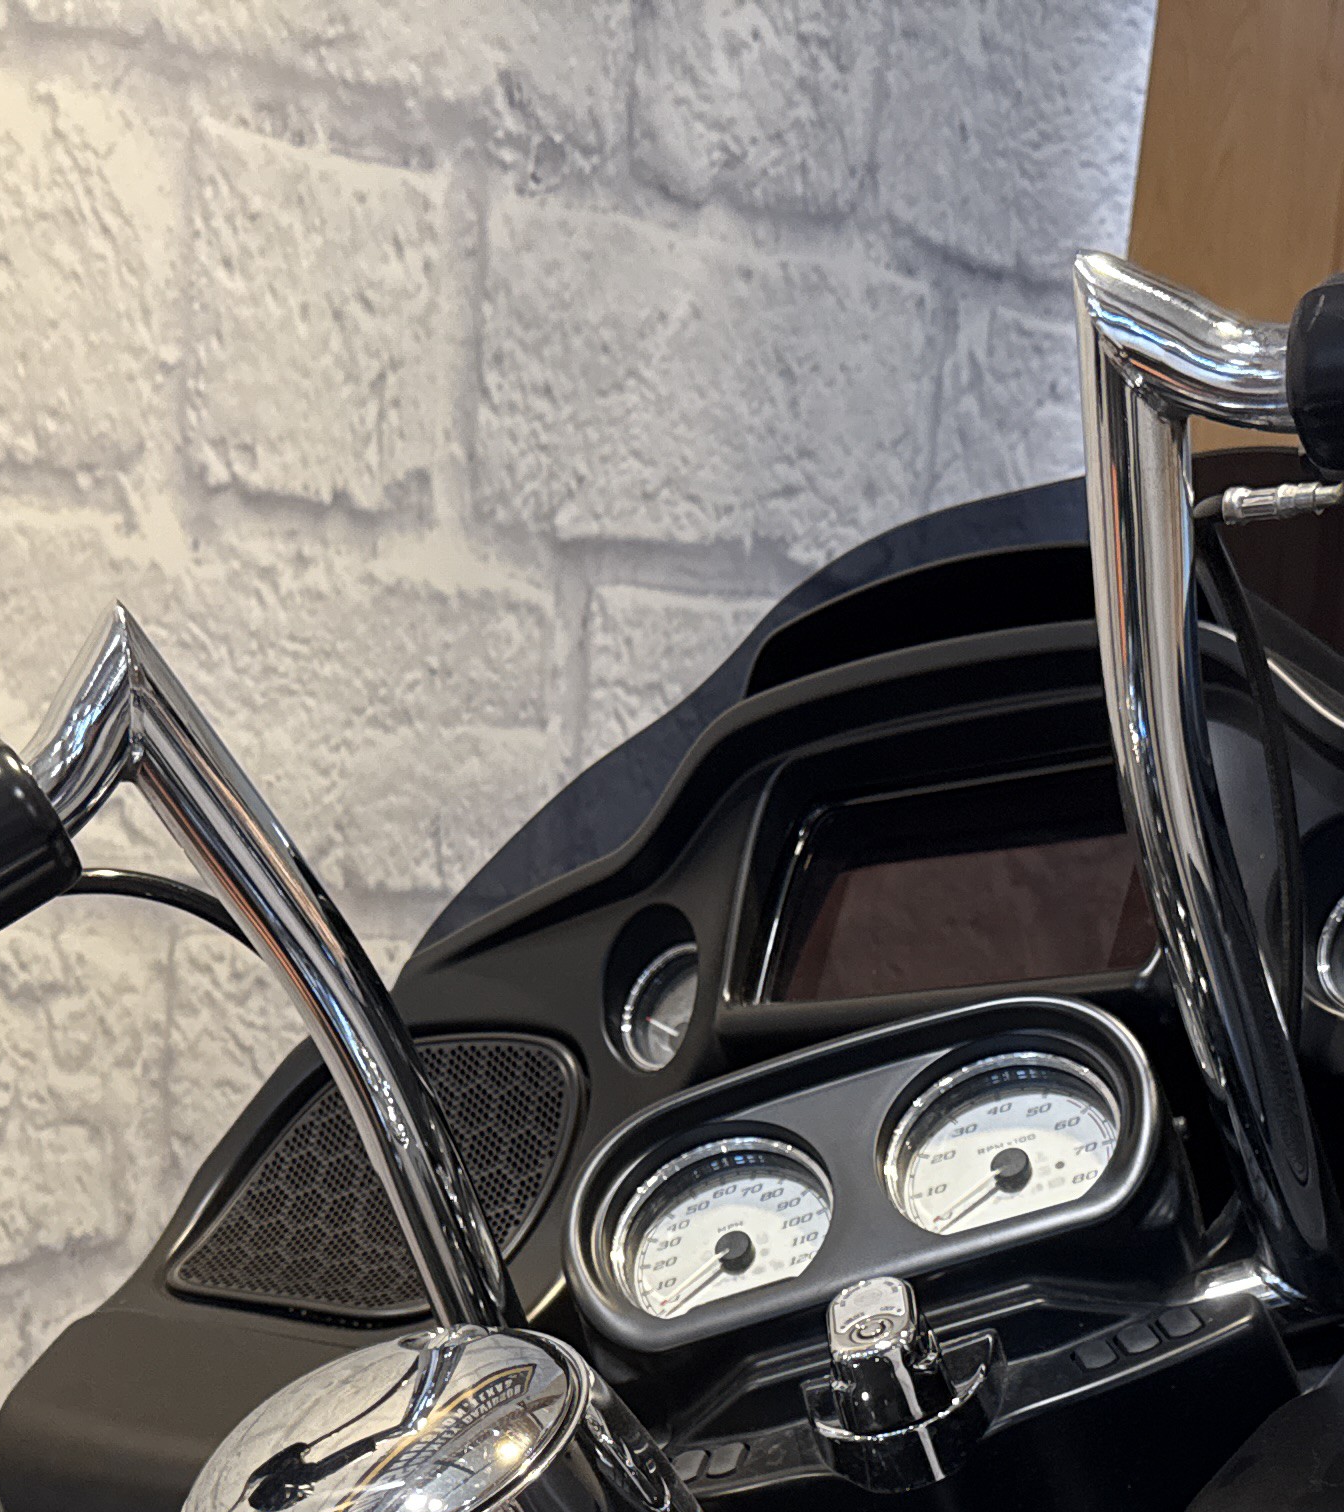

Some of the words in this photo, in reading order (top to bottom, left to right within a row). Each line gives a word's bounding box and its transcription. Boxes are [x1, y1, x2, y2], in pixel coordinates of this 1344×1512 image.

[986, 1102, 1013, 1116] 40
[1025, 1103, 1052, 1118] 50
[951, 1123, 978, 1138] 30
[1054, 1116, 1081, 1131] 60
[1073, 1142, 1097, 1156] 70
[930, 1150, 957, 1165] 20
[1072, 1170, 1099, 1185] 80
[712, 1184, 737, 1199] 60
[741, 1183, 763, 1198] 70
[760, 1187, 784, 1202] 80
[926, 1184, 948, 1197] 10
[685, 1200, 710, 1216] 50
[776, 1197, 801, 1212] 90
[666, 1219, 690, 1232] 40
[780, 1212, 814, 1230] 100
[657, 1236, 682, 1252] 30
[791, 1231, 819, 1248] 110
[653, 1256, 678, 1271] 20
[788, 1250, 818, 1267] 120
[657, 1277, 677, 1291] 10
